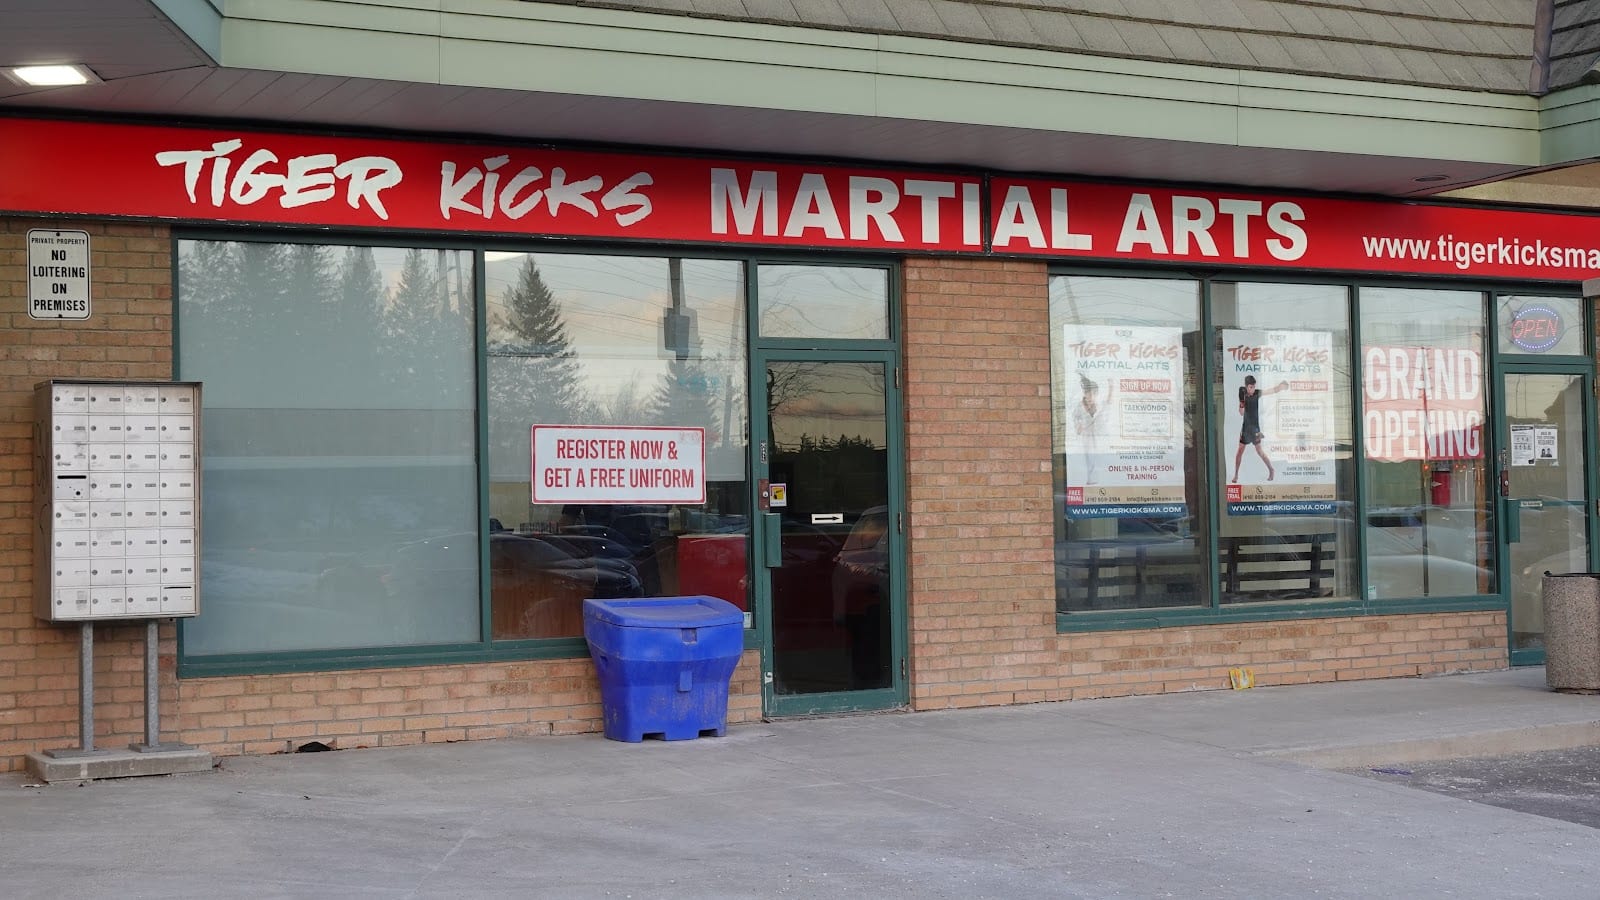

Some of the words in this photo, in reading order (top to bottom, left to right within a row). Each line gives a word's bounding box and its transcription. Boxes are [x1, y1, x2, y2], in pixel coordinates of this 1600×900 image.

[710, 168, 1092, 250] MARTIAL
[1115, 193, 1309, 262] ARTS
[51, 249, 66, 261] NO
[33, 266, 85, 278] LOITERING
[52, 283, 67, 294] ON
[34, 299, 86, 311] PREMISES
[1512, 319, 1558, 339] OPEN
[1077, 360, 1132, 370] MARTIAL
[1136, 361, 1170, 371] ARTS
[1235, 363, 1288, 373] MARTIAL
[1290, 364, 1321, 373] ARTS
[1365, 347, 1479, 401] GRAND
[1121, 381, 1138, 391] SIGN
[1141, 381, 1150, 391] UP
[1152, 381, 1169, 391] NOW
[1124, 404, 1167, 412] TAEKWONDO
[1366, 410, 1480, 458] OPENING
[556, 439, 625, 459] REGISTER
[630, 440, 663, 460] NOW
[667, 440, 678, 460] &
[544, 468, 572, 488] GET
[576, 468, 586, 488] A
[590, 468, 625, 488] FREE
[629, 468, 694, 488] UNIFORM
[1072, 506, 1181, 515] WWW.TIGERKICKSMA.COM
[1231, 504, 1331, 512] WWW.TIGERKICKSMA.COM
